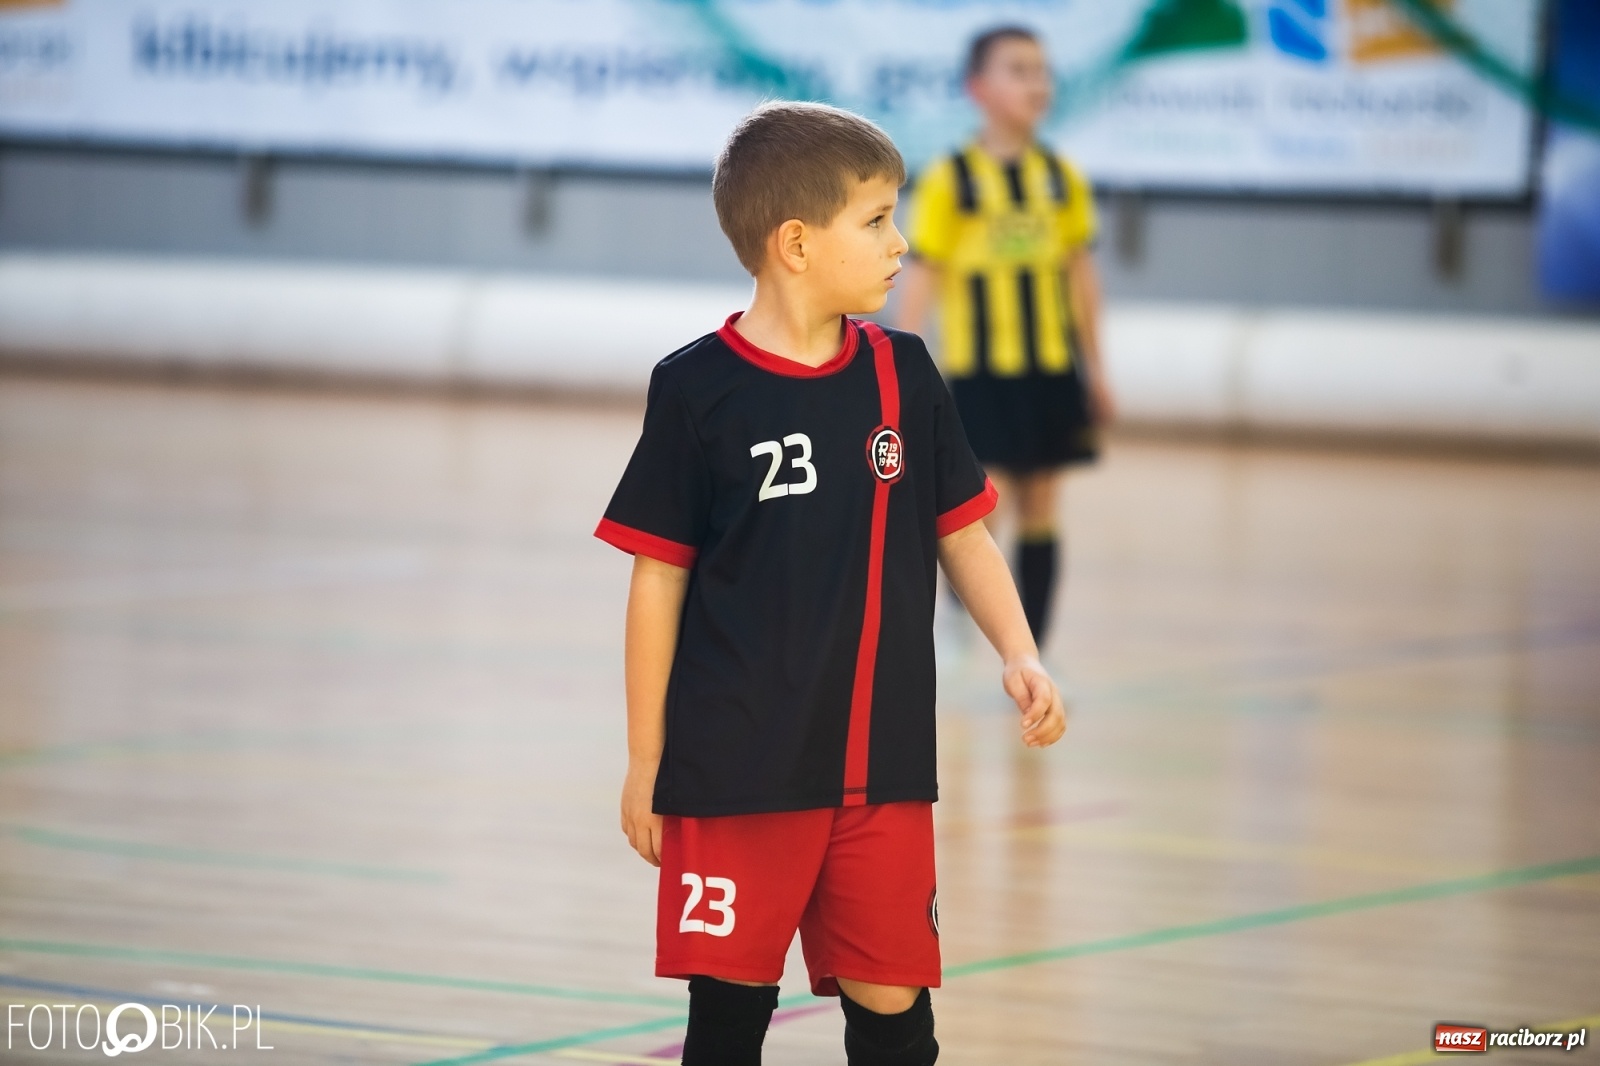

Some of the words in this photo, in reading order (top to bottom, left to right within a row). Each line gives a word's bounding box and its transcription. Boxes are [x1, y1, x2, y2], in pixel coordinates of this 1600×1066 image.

[750, 432, 817, 502] 23
[878, 441, 889, 457] R
[888, 443, 898, 453] 19
[878, 457, 886, 467] 19
[885, 453, 898, 468] R
[679, 872, 737, 937] 23
